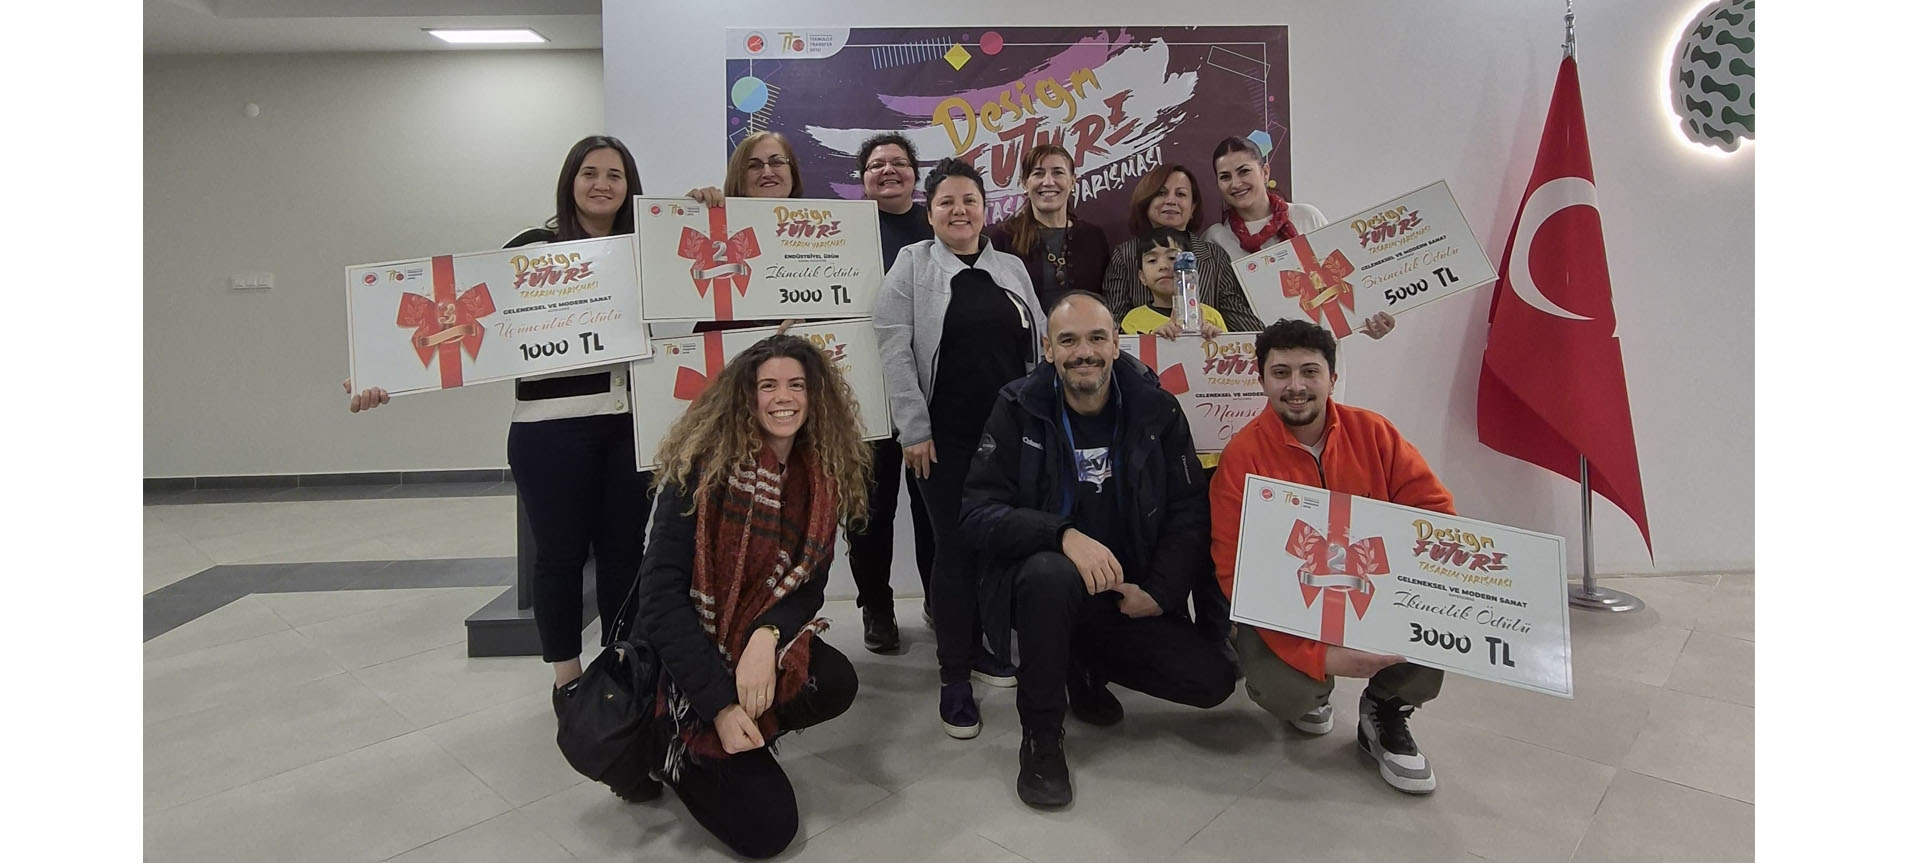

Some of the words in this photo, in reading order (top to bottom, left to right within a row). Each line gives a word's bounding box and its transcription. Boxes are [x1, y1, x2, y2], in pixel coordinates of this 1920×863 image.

[932, 67, 1101, 156] Design
[773, 206, 832, 224] Design
[776, 220, 842, 238] FUTURE
[1350, 206, 1408, 235] Design
[510, 252, 581, 273] Design
[514, 261, 594, 289] FUTURE
[779, 288, 822, 304] 3000
[830, 284, 851, 305] TL
[1384, 279, 1428, 306] 5000
[1432, 267, 1459, 287] TL
[503, 305, 547, 315] GELENEKSEL
[558, 299, 588, 307] MODERN
[520, 340, 568, 361] 1000
[578, 332, 604, 354] TL
[1202, 340, 1257, 359] Desig
[1412, 519, 1494, 553] Design
[1412, 540, 1509, 573] FUTURE
[1420, 561, 1460, 579] TASARIM
[1397, 576, 1448, 592] GELENEKSEL
[1448, 586, 1460, 594] VE
[1462, 588, 1498, 602] MODERN
[1499, 597, 1528, 608] SANAT
[1393, 588, 1474, 620] İkincilik
[1476, 606, 1532, 634] Ödülü
[1409, 622, 1472, 654] 3000
[1484, 636, 1515, 668] TL
